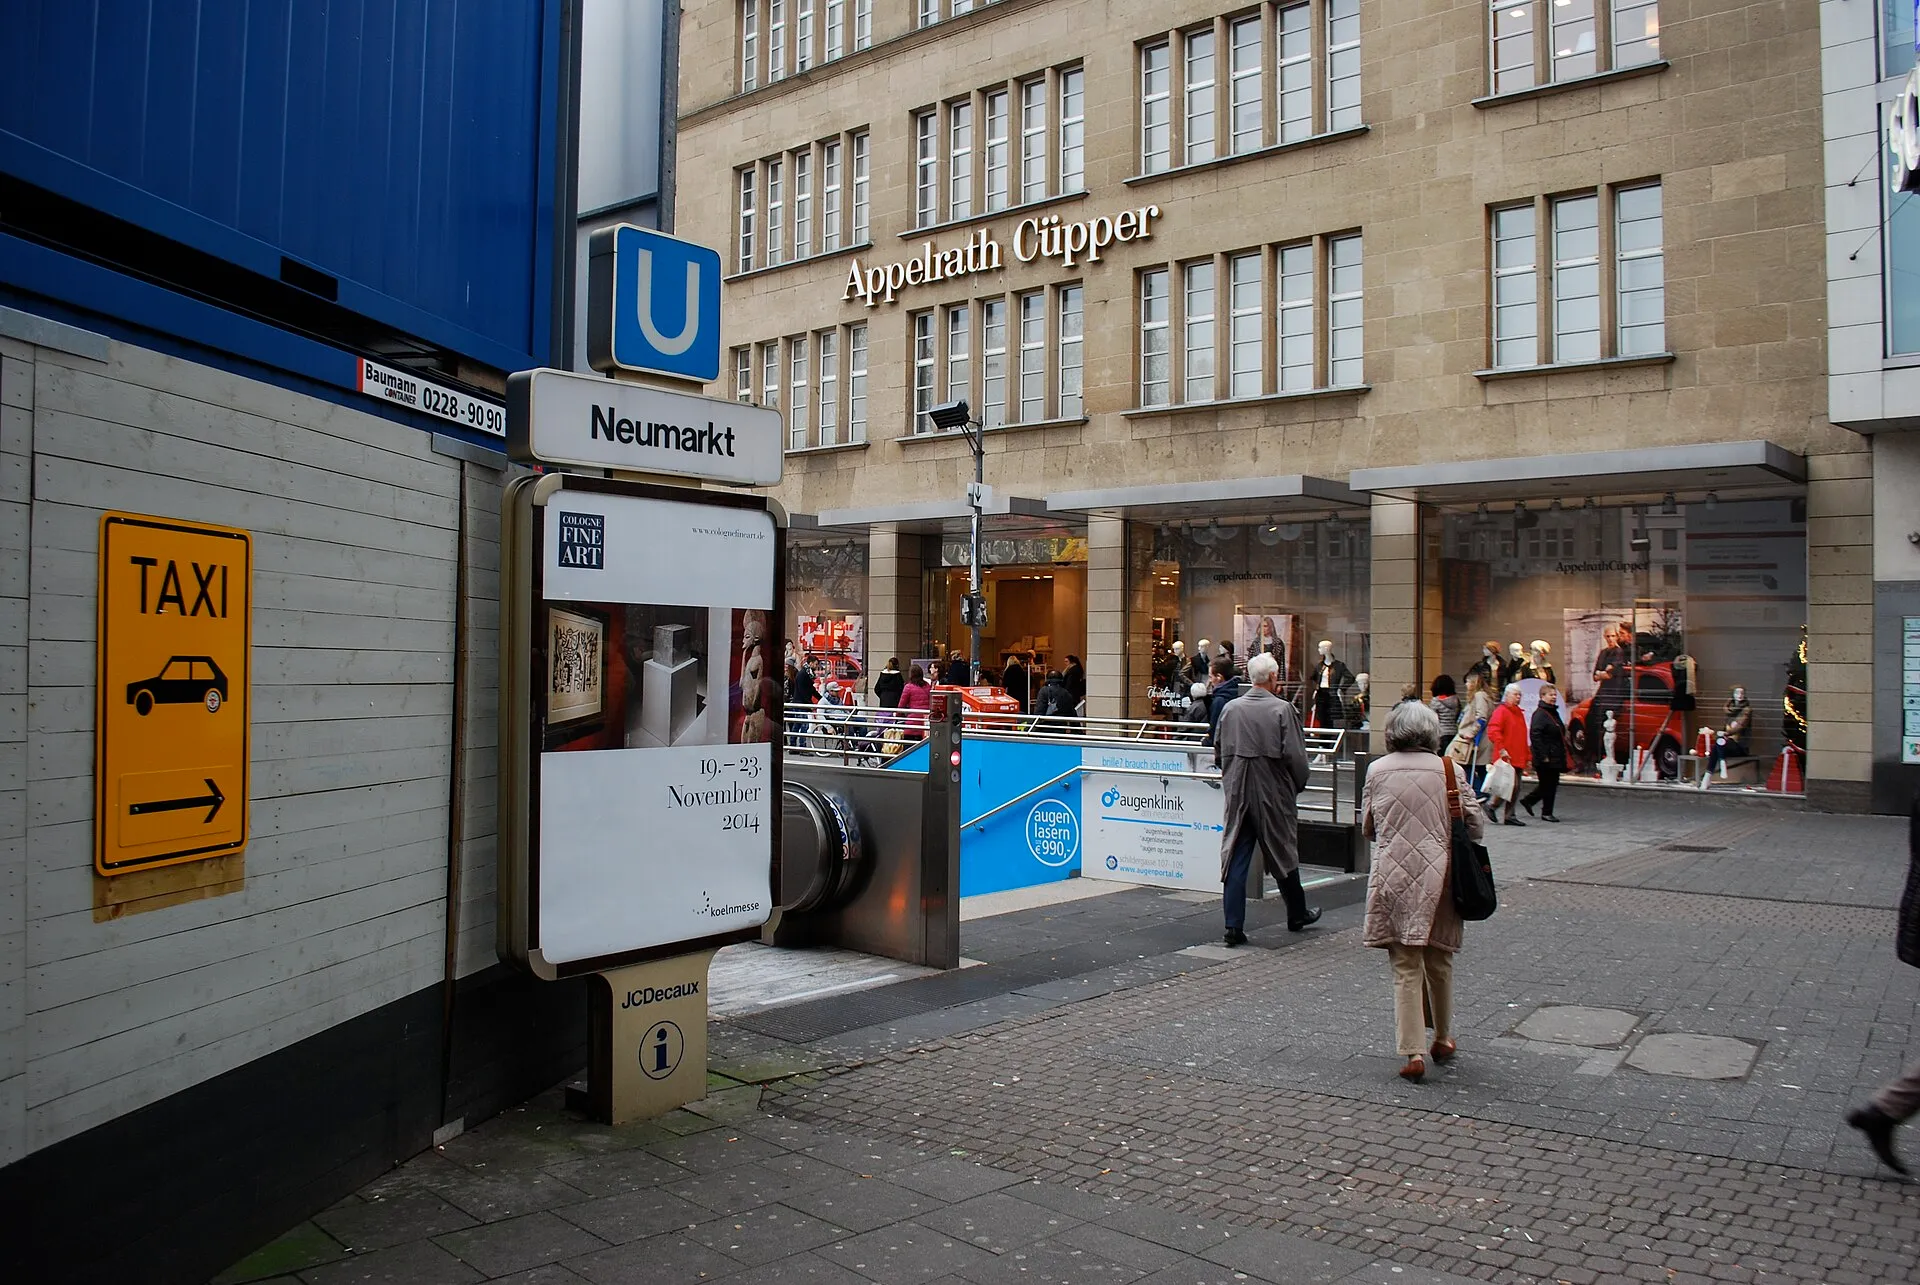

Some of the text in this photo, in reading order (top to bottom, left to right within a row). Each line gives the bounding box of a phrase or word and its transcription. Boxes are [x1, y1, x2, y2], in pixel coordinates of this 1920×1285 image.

[841, 204, 1162, 307] Appelrath Cüpper
[637, 247, 701, 356] U
[365, 362, 417, 395] Baumann
[384, 387, 417, 406] CONTAINER
[591, 404, 736, 458] Neumarkt
[562, 515, 602, 528] COLOGNE
[562, 526, 602, 545] FINE
[692, 526, 766, 540] www.colognefineart.de
[561, 546, 602, 566] ART
[1213, 571, 1272, 583] appelrath.com
[130, 555, 228, 619] TAXI
[1161, 700, 1181, 708] ROME
[1102, 756, 1183, 771] brille? brauch ich nicht!
[667, 780, 762, 809] November
[1119, 794, 1185, 812] augenklinik
[722, 812, 760, 834] 2014
[1034, 810, 1070, 827] augen
[1034, 822, 1070, 841] lasern
[1119, 866, 1184, 879] www.augenportal.de
[710, 901, 760, 917] koelnmesse
[621, 981, 700, 1009] JCDecaux
